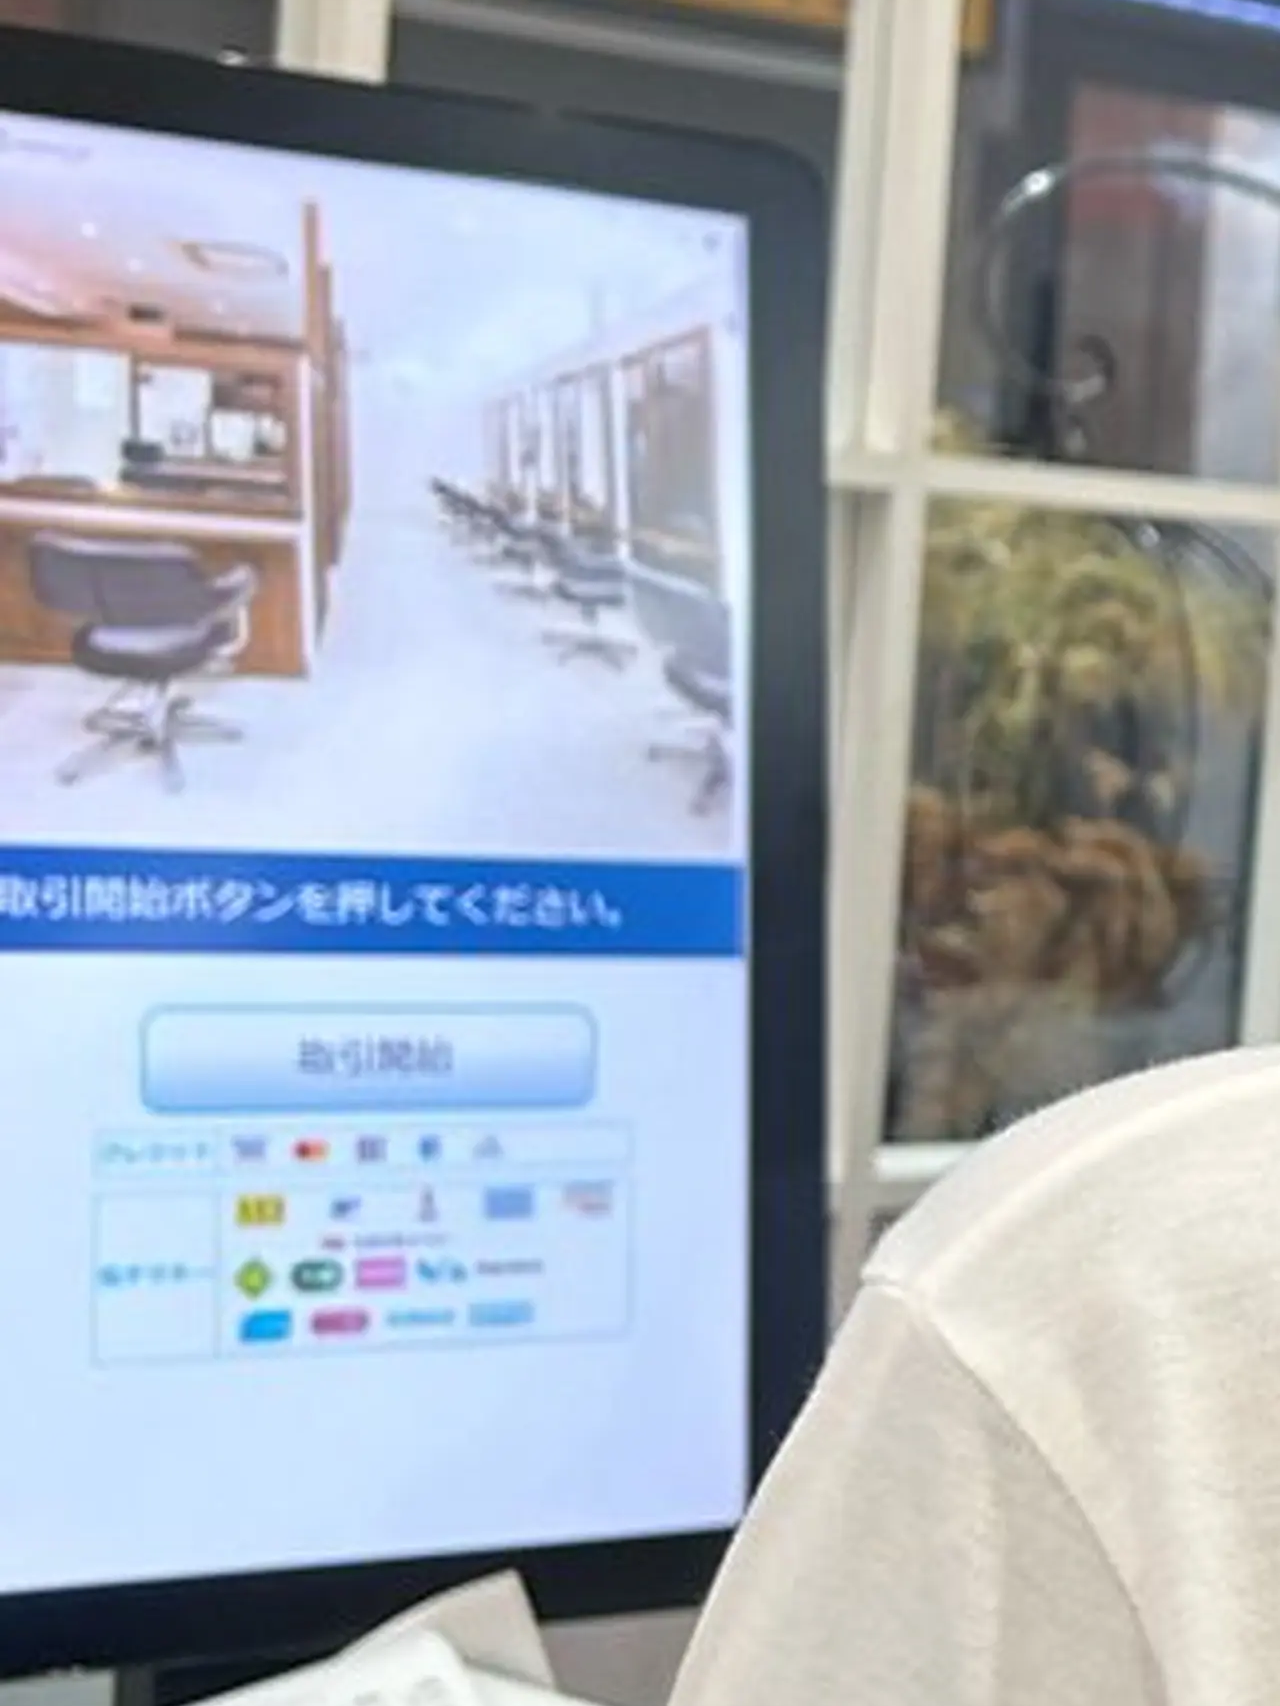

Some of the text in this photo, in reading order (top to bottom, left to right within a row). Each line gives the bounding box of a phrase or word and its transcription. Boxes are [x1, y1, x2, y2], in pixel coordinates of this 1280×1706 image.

[0, 873, 624, 931] 取引開始ボタンを押してください。
[297, 1032, 455, 1078] 取引開始
